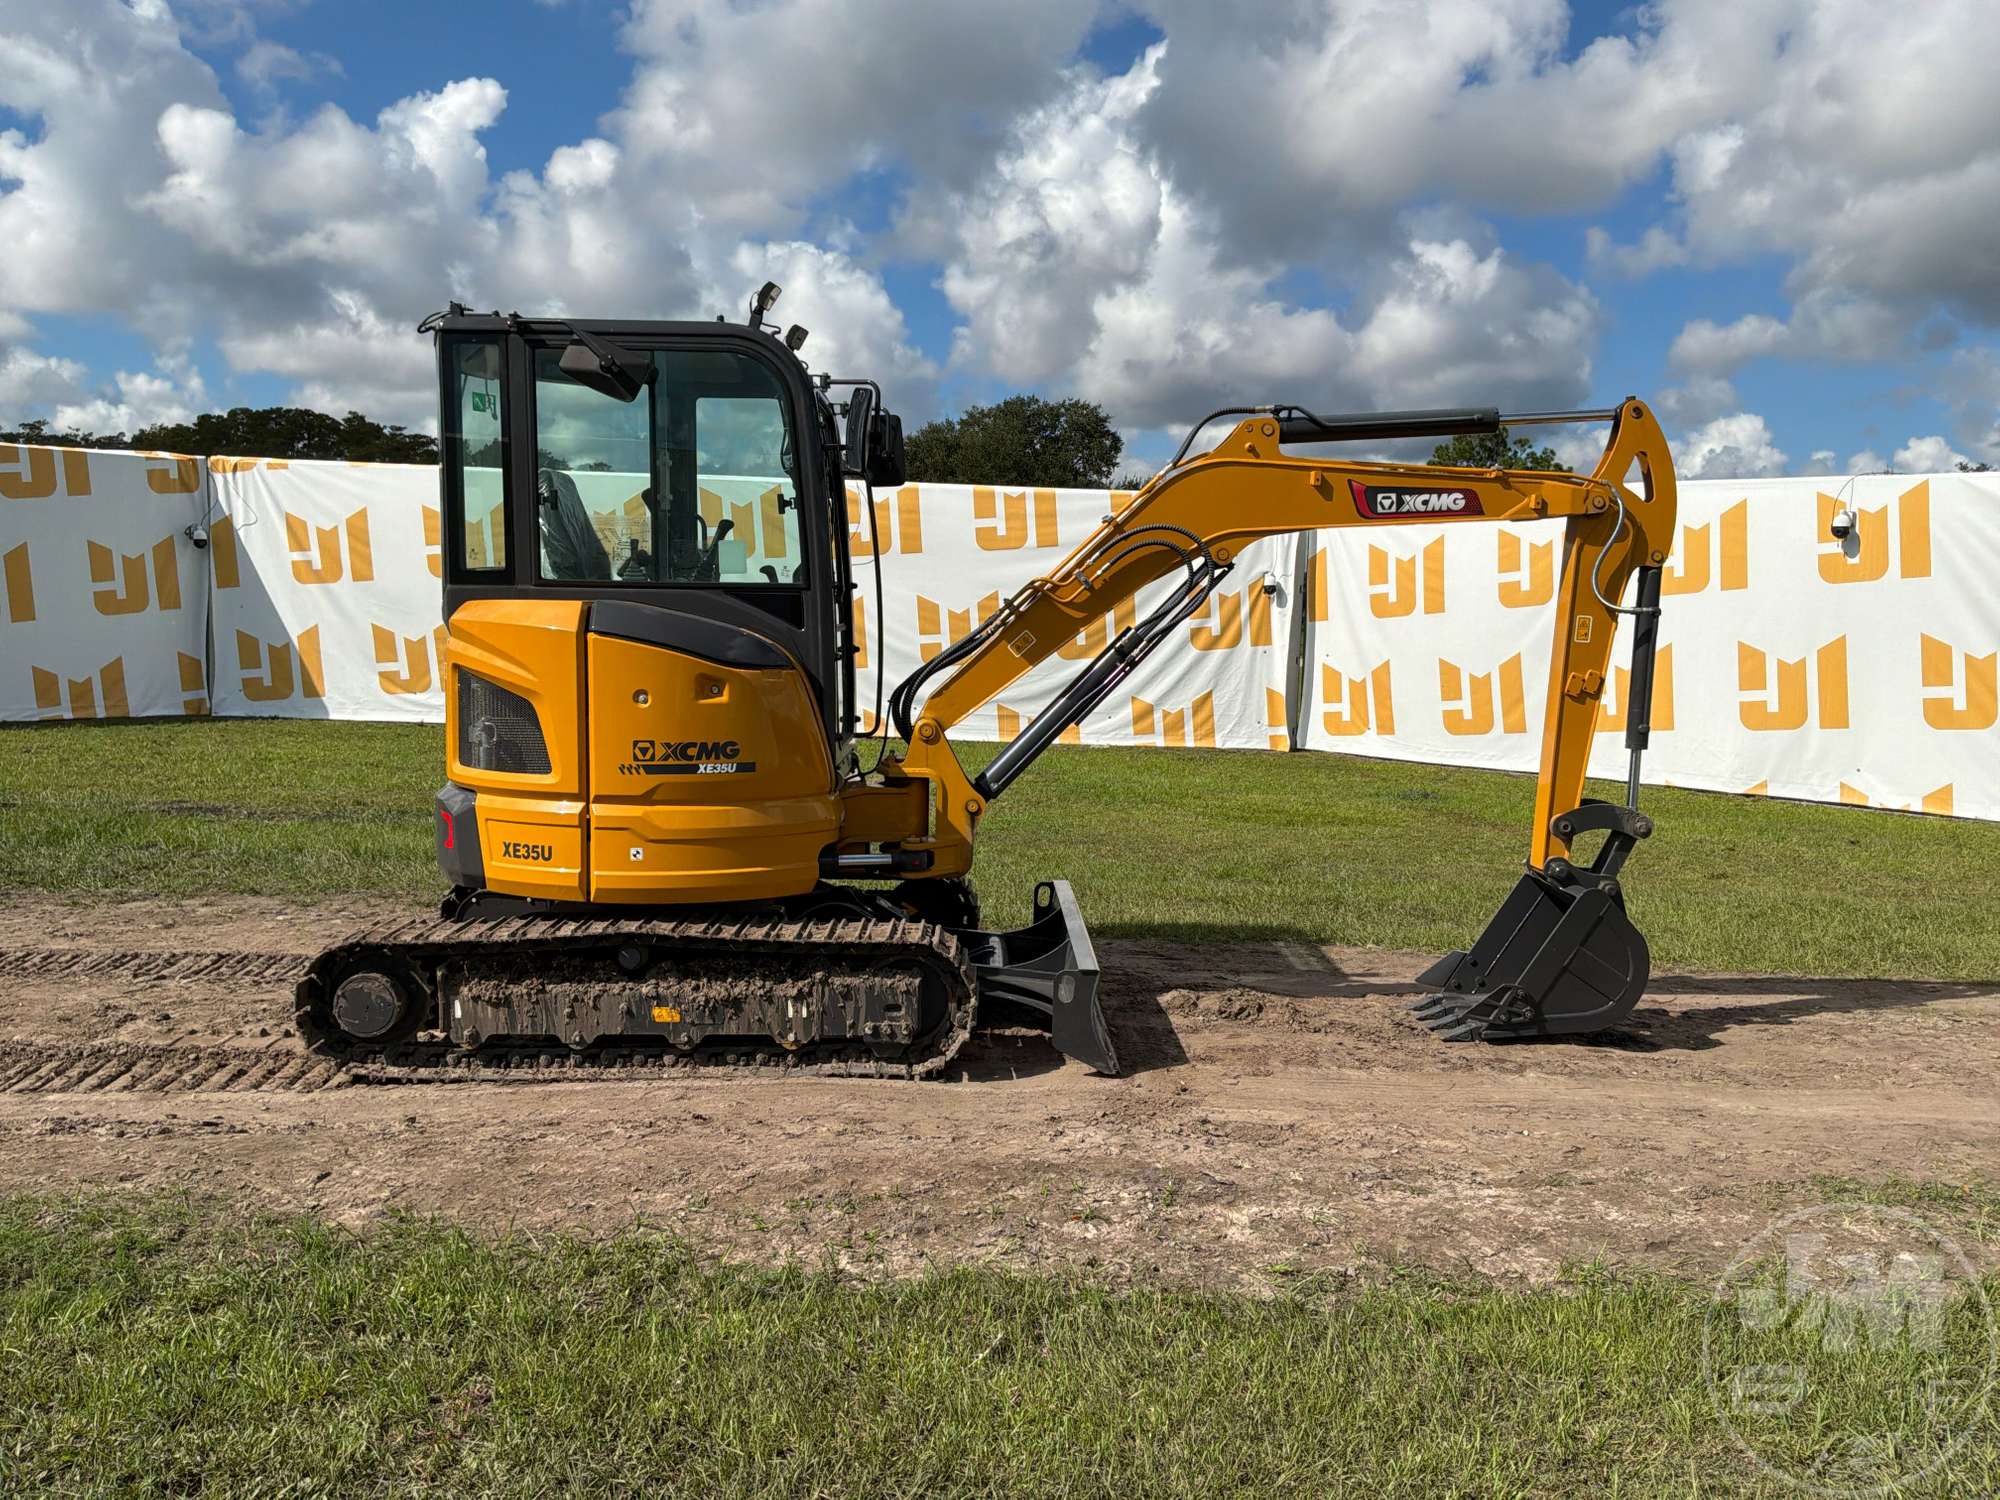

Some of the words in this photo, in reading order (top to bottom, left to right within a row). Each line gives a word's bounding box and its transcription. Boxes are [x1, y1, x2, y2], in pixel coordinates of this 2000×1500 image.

[1398, 492, 1466, 512] XCMG
[656, 740, 741, 762] XCMG
[697, 763, 737, 774] XE35U
[502, 841, 553, 862] XE35U
